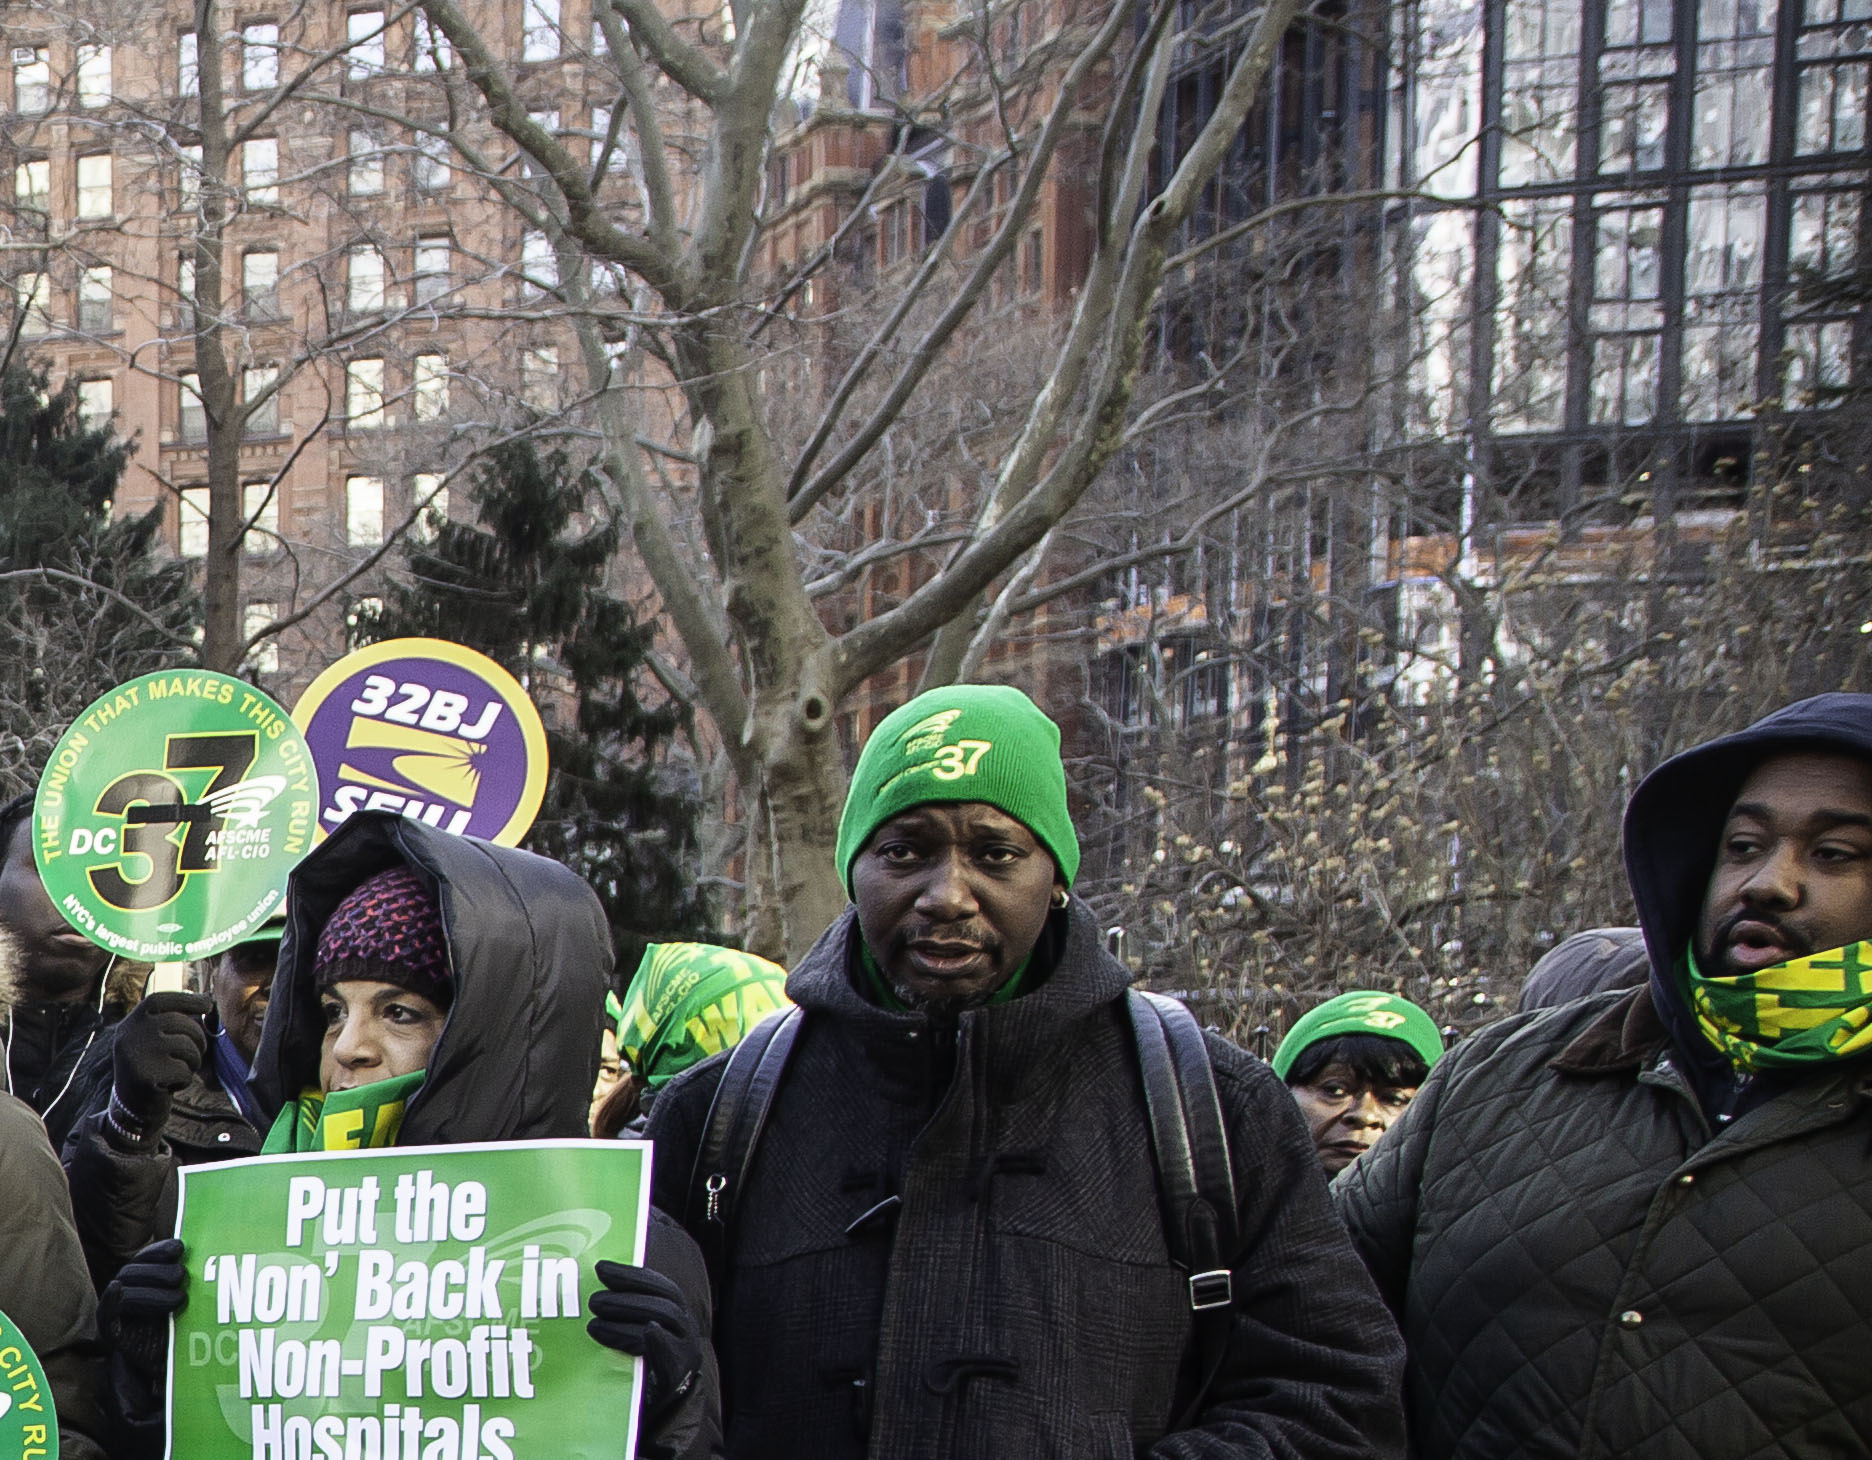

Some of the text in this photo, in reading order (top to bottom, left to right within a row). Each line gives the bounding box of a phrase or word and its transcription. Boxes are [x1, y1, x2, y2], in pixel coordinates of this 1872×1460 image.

[351, 675, 503, 740] 32BJ
[41, 677, 310, 863] THE UNION THAT MAKES THIS CITY RUN
[932, 739, 992, 780] 37
[68, 730, 260, 913] DC 37
[204, 828, 271, 846] AFSCME
[95, 923, 139, 953] largest
[140, 940, 184, 956] public
[185, 918, 248, 954] employee
[246, 889, 280, 923] union
[285, 1170, 487, 1247] Put the
[354, 1245, 506, 1323] Back
[520, 1244, 581, 1319] in
[238, 1325, 535, 1400] Non-Profit
